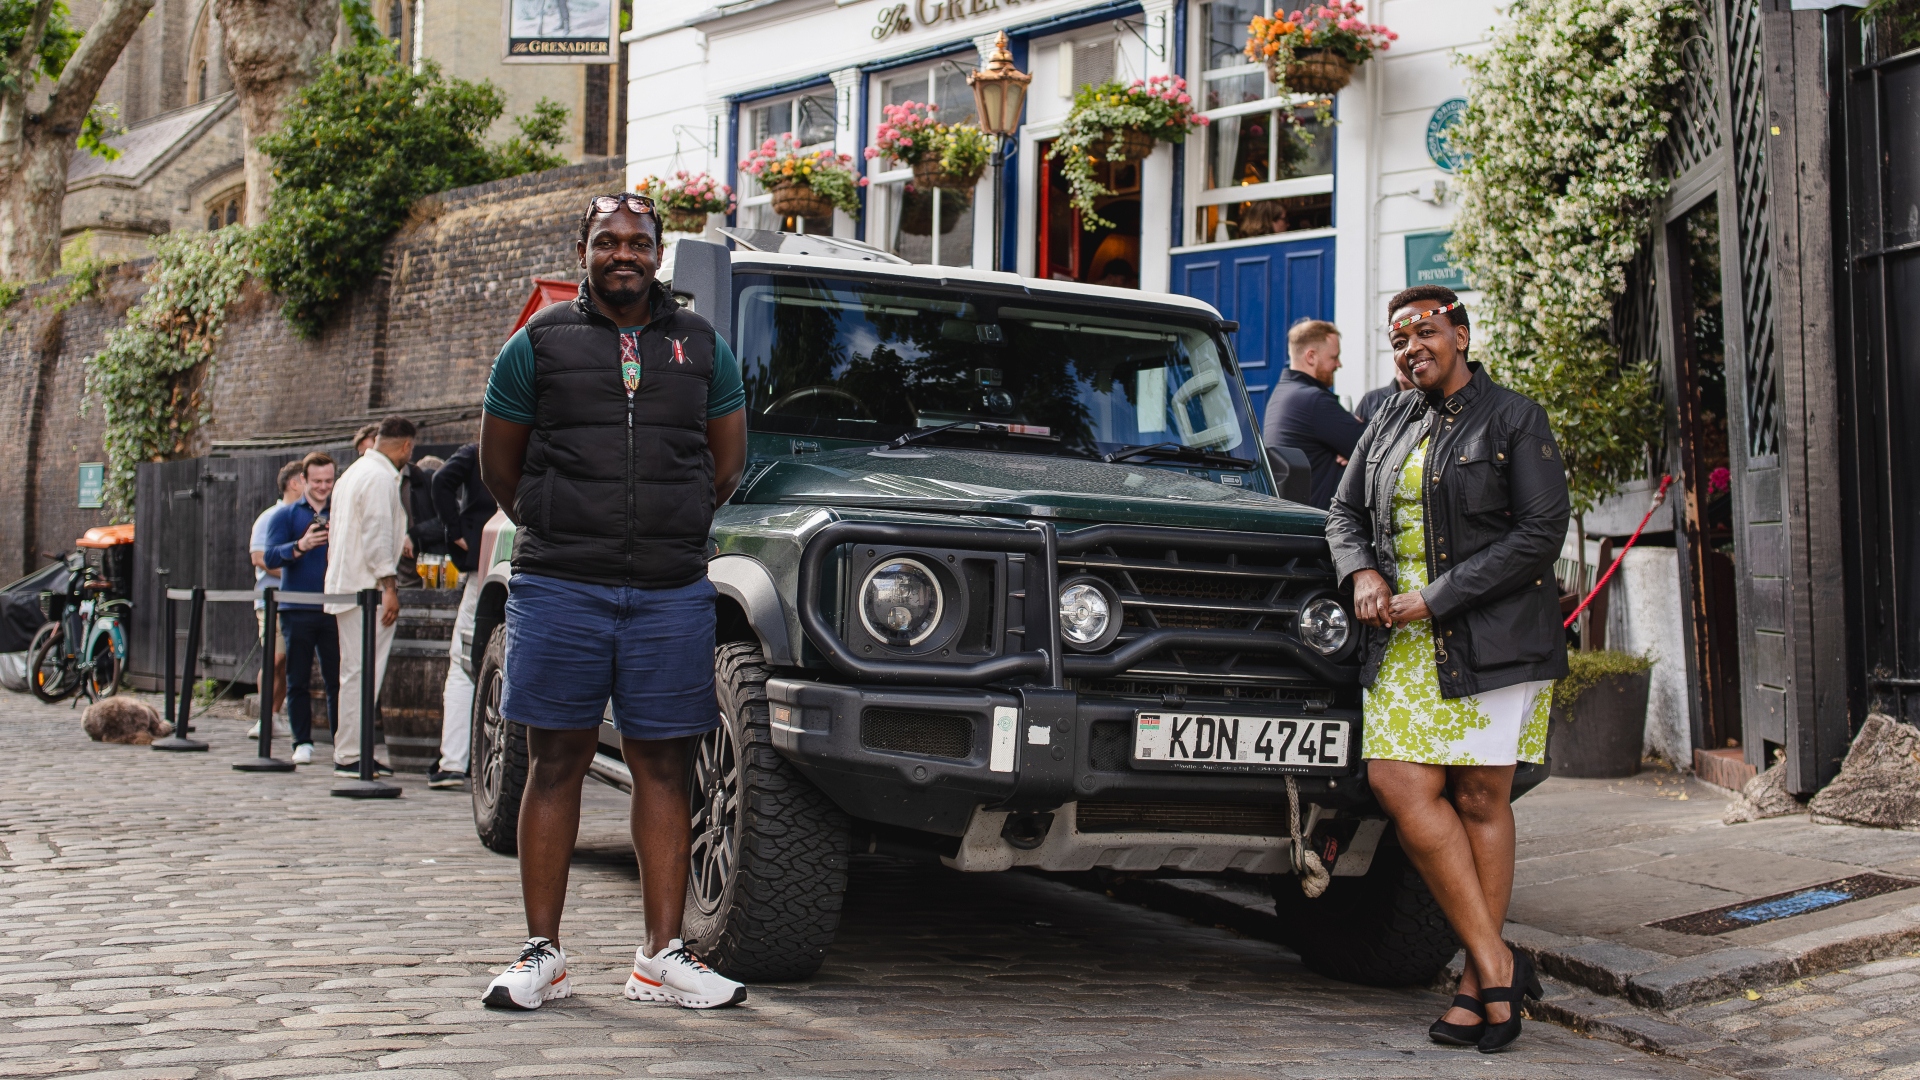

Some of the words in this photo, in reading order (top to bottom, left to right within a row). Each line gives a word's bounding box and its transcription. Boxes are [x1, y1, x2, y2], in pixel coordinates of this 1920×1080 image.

[872, 3, 912, 40] The
[528, 40, 608, 53] GRENADIER
[1417, 267, 1457, 281] PRIVATE
[1168, 716, 1240, 761] KDN
[1254, 720, 1341, 764] 474E
